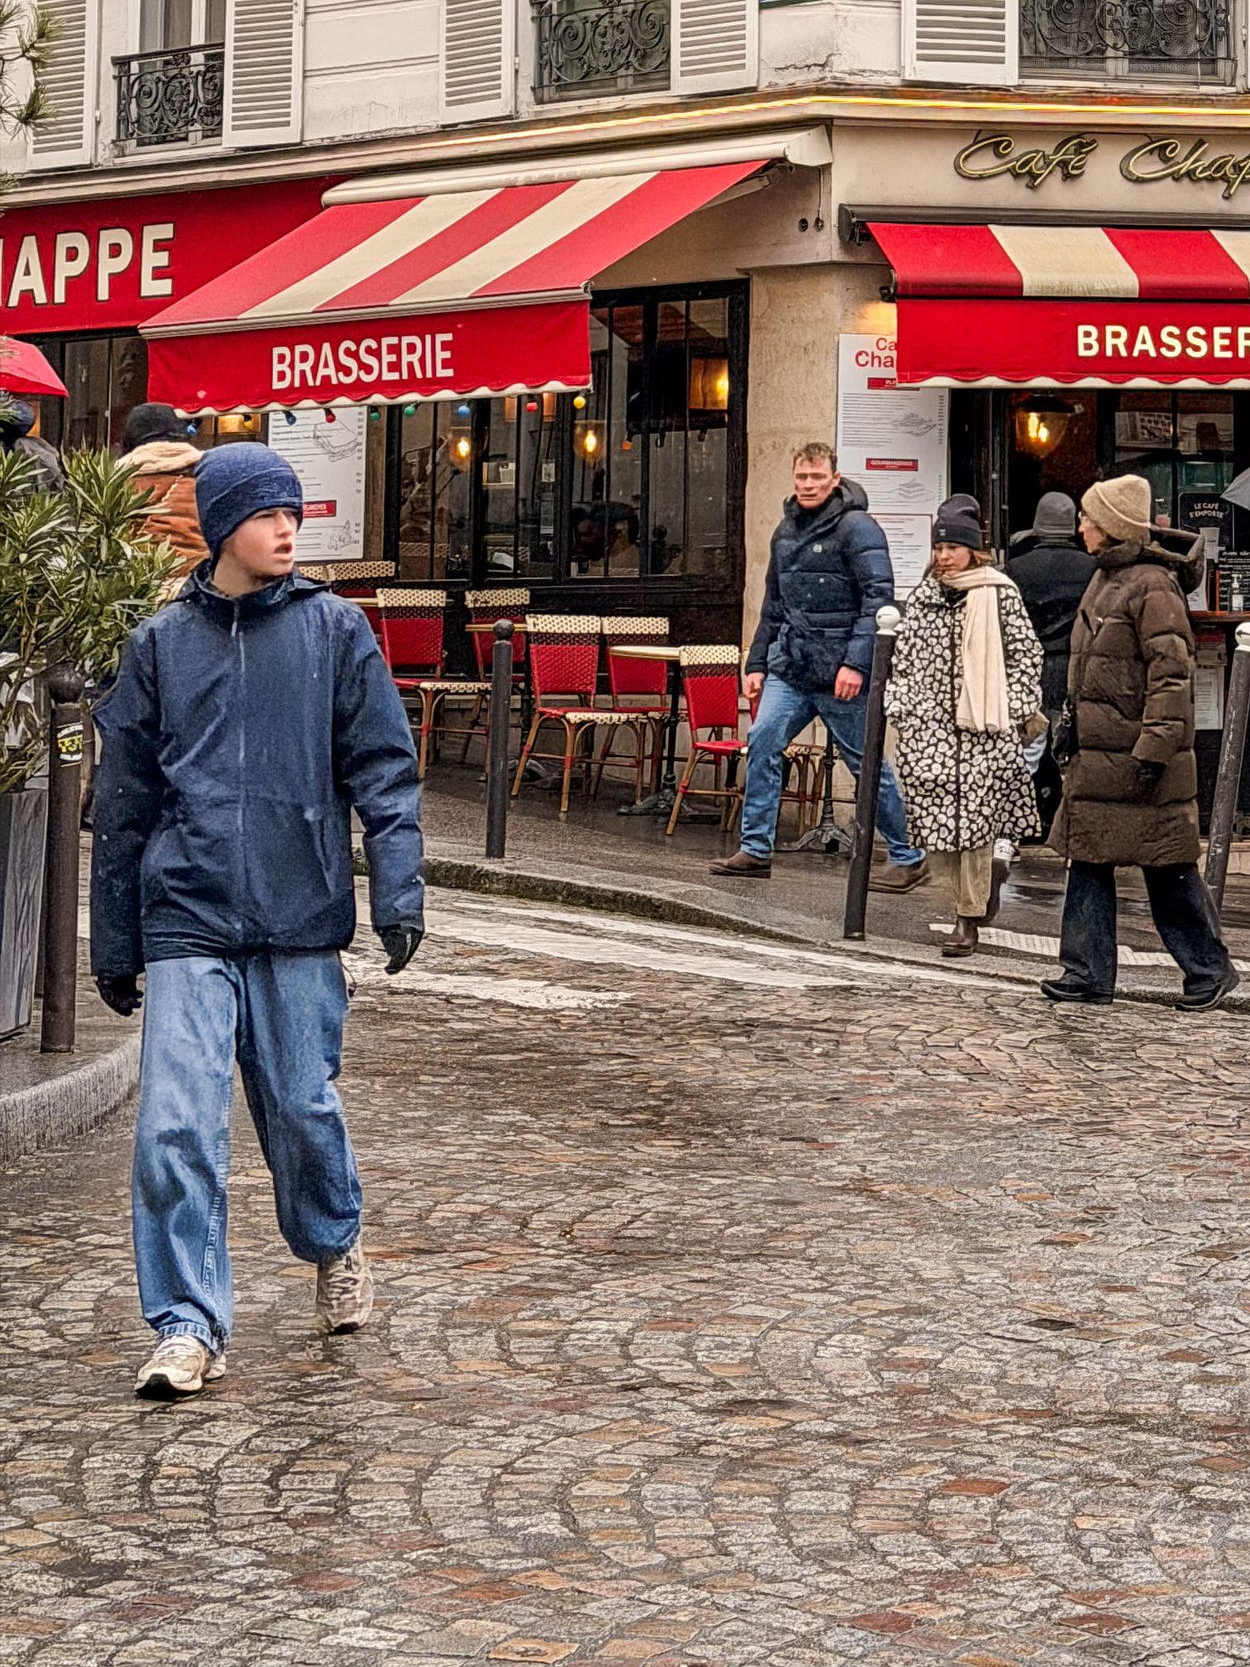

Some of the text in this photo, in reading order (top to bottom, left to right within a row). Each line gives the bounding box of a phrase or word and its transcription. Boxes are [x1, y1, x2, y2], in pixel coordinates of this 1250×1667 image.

[955, 134, 1098, 189] Café
[0, 223, 174, 308] APPE
[271, 332, 455, 390] BRASSERIE
[854, 350, 896, 368] Cha
[875, 337, 897, 352] Ca
